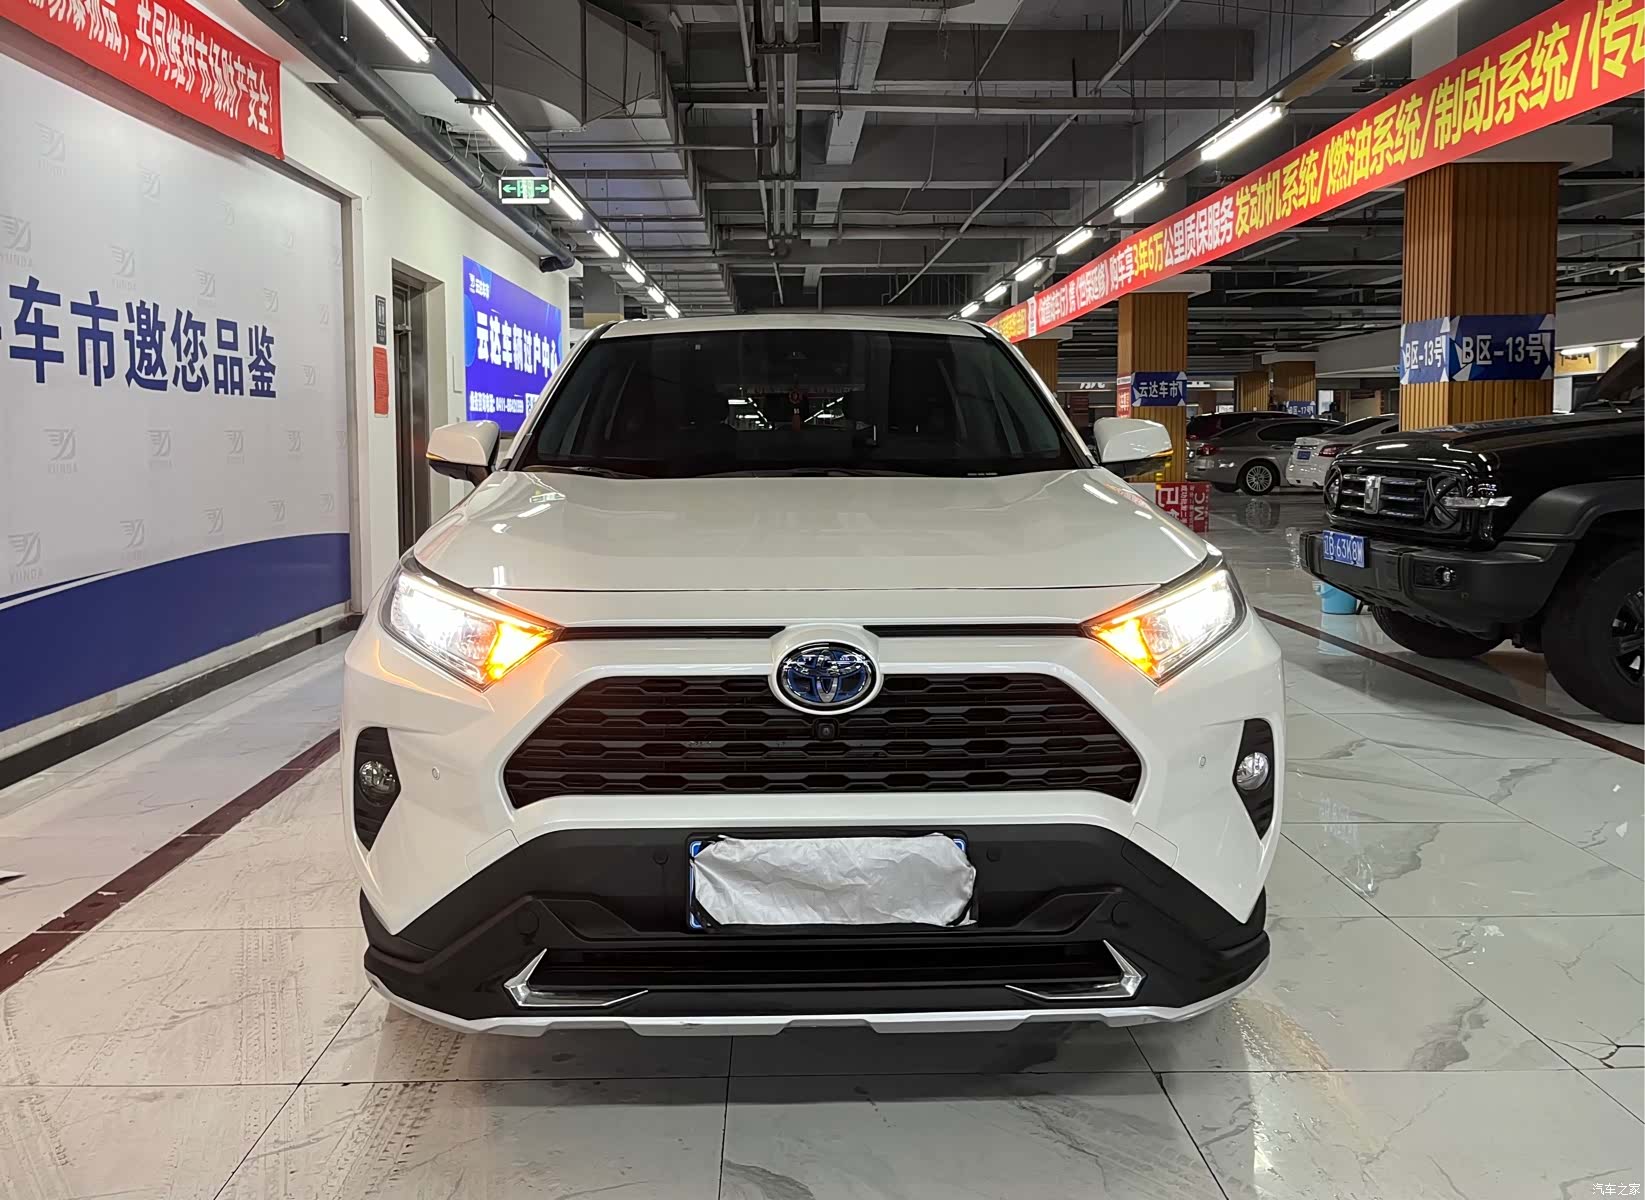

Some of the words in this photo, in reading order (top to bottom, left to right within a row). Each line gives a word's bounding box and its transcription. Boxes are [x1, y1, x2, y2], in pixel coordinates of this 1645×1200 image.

[0, 275, 276, 398] 车市邀您品鉴
[1405, 334, 1443, 369] B区-13号
[1462, 333, 1543, 365] B区-13号
[1139, 380, 1178, 398] 云达车市
